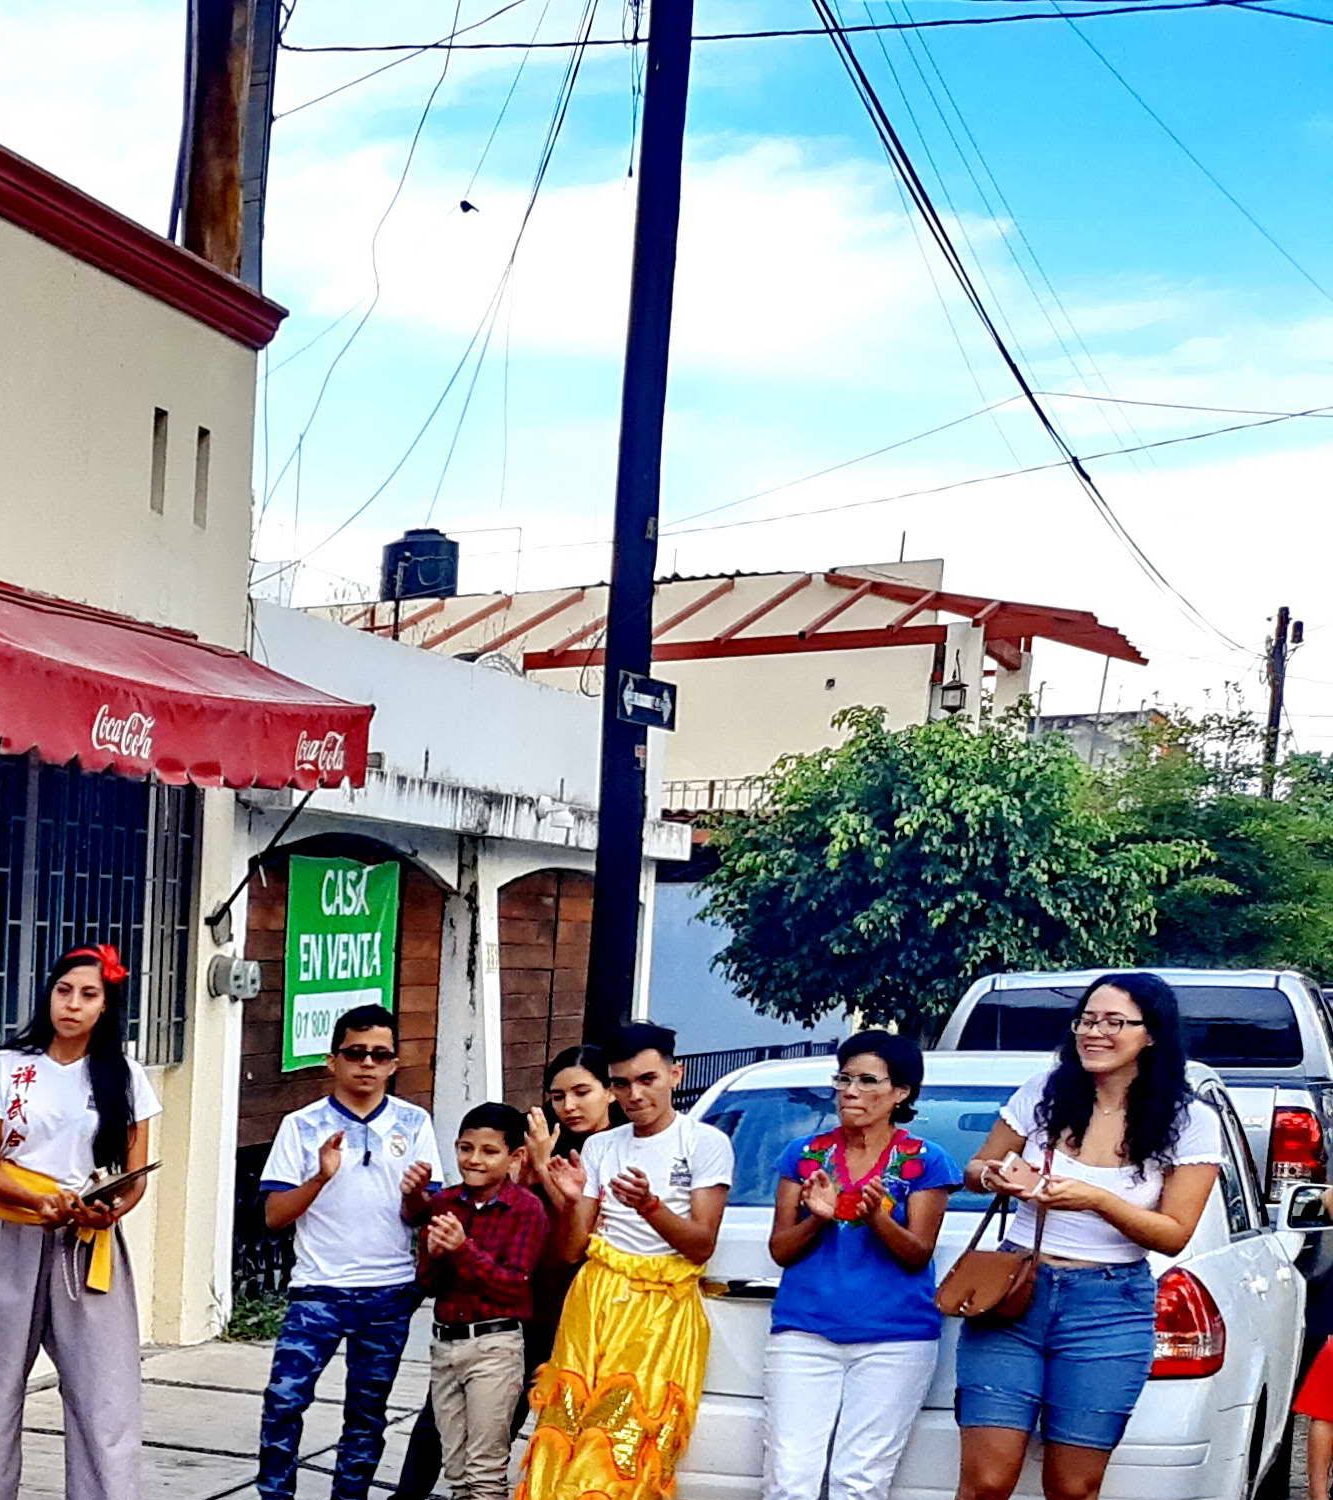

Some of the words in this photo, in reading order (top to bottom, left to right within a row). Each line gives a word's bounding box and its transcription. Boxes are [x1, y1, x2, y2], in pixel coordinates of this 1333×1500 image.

[321, 866, 369, 916] CASA
[299, 933, 323, 982] EN
[328, 932, 381, 979] VENTA
[295, 1011, 309, 1039] 01
